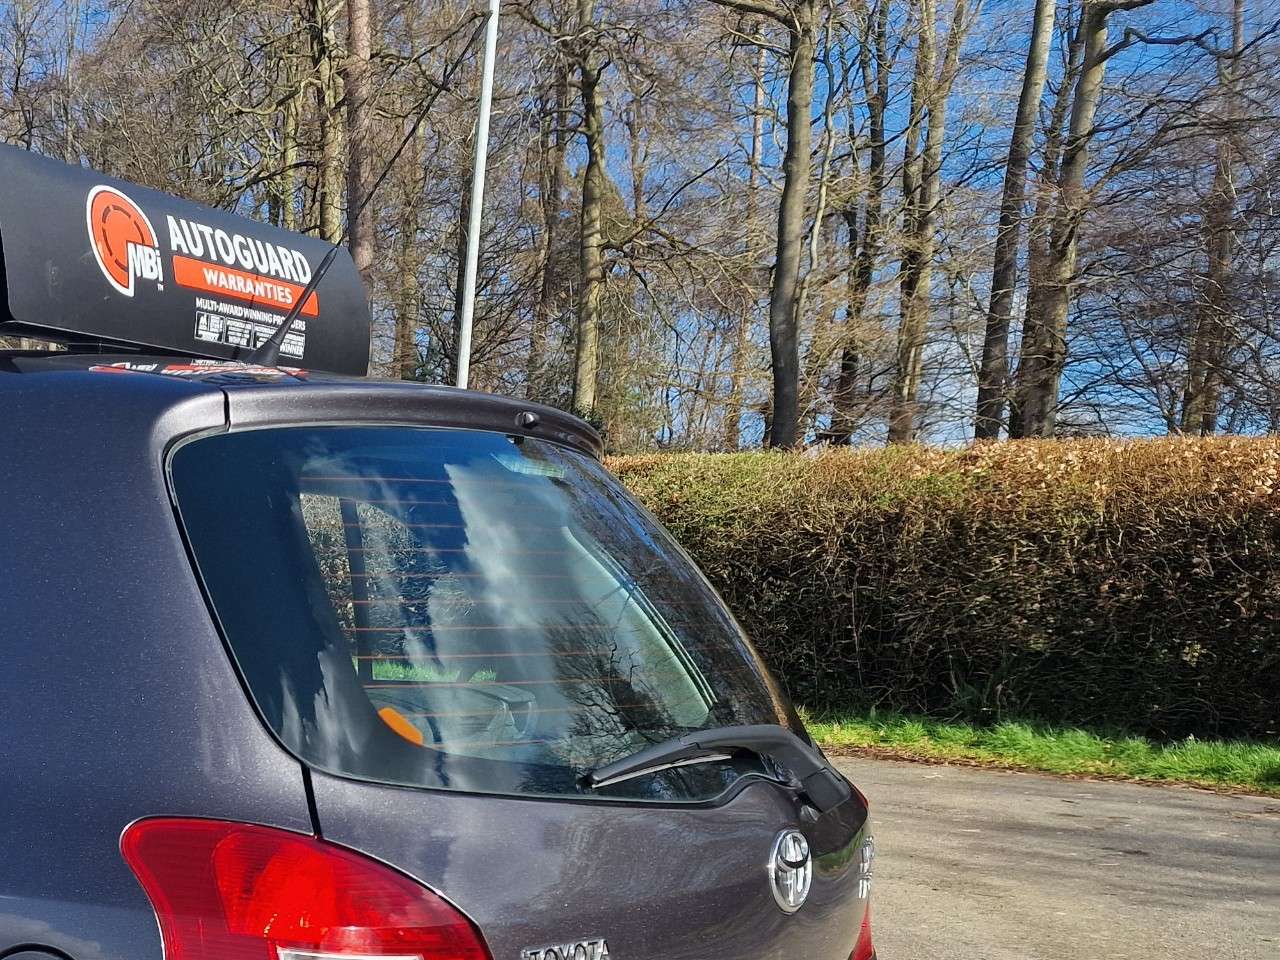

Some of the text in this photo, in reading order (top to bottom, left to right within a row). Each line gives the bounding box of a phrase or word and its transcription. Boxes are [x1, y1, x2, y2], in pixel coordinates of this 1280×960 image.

[166, 214, 312, 285] AUTOGUARD
[203, 267, 293, 304] WARRANTIES
[243, 307, 273, 324] WINNING
